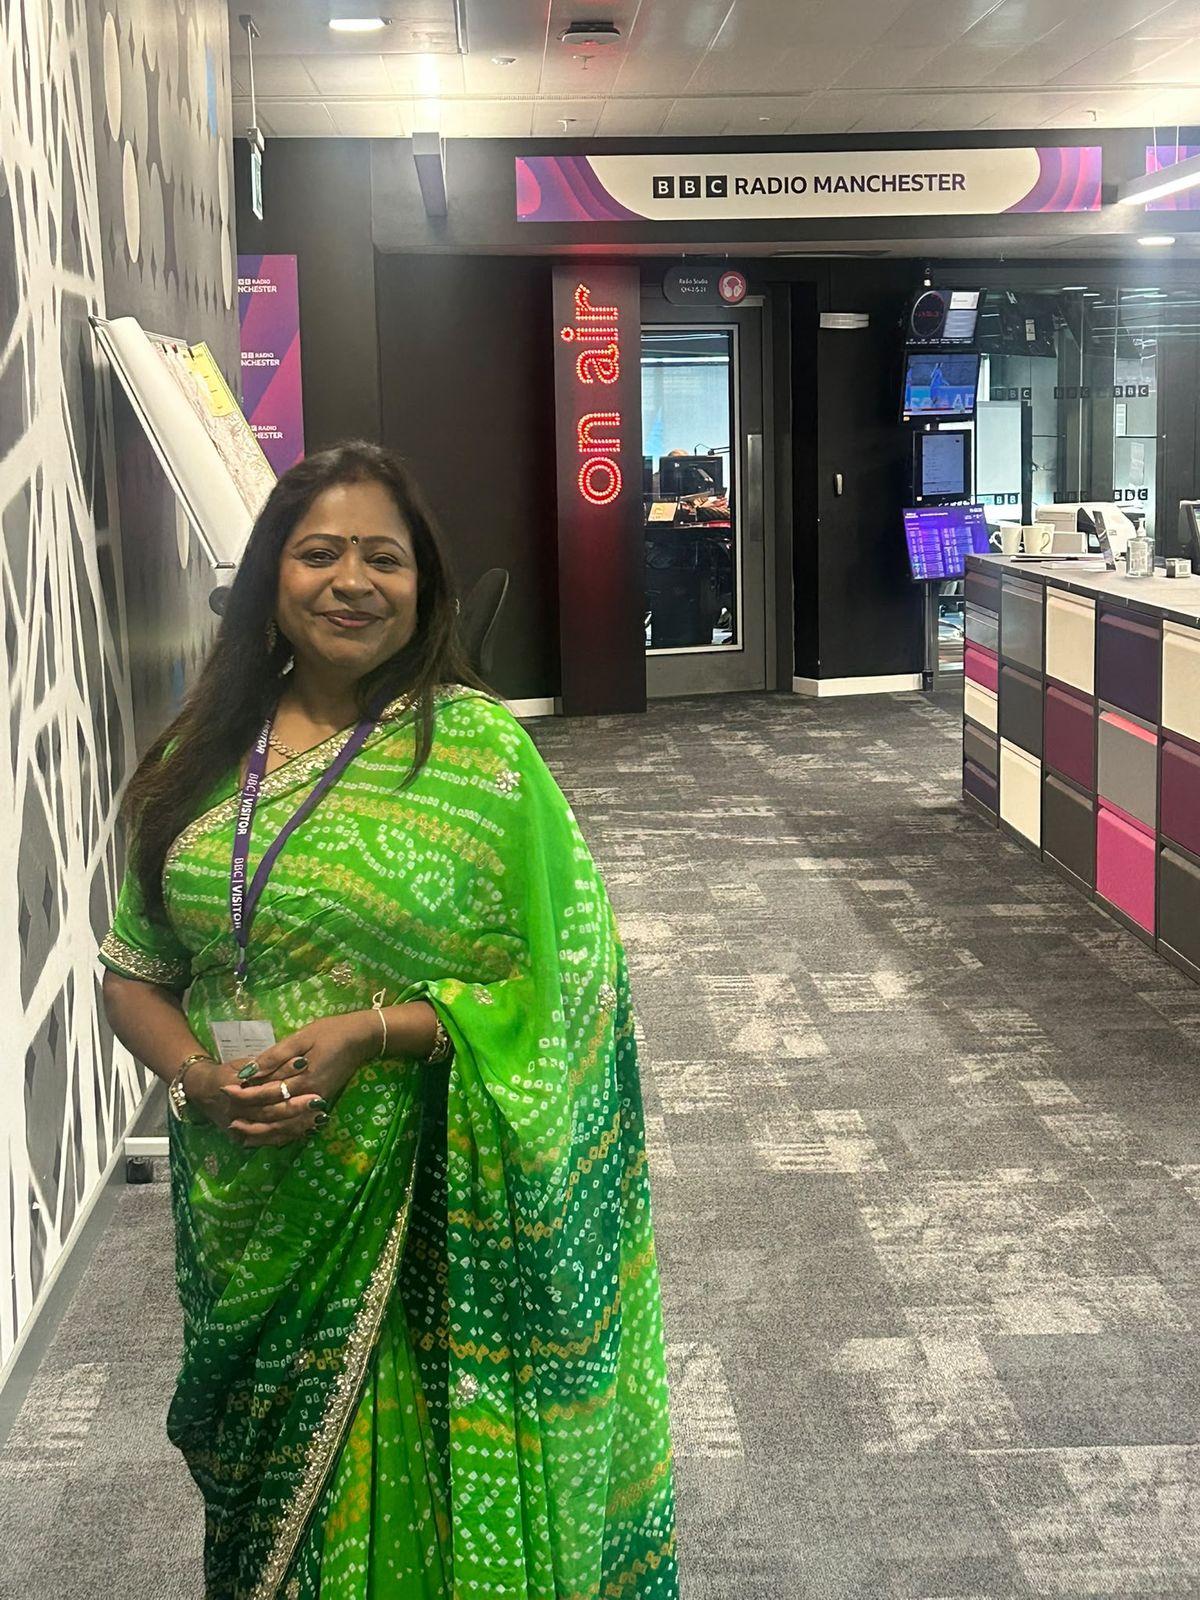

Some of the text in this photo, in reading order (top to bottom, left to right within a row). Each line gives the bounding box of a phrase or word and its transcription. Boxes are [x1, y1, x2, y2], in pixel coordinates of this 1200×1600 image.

[653, 173, 966, 198] BBC RADIO MANCHESTER
[560, 283, 622, 505] on air
[1114, 385, 1149, 398] BBC
[237, 772, 259, 836] BBC VISITOR
